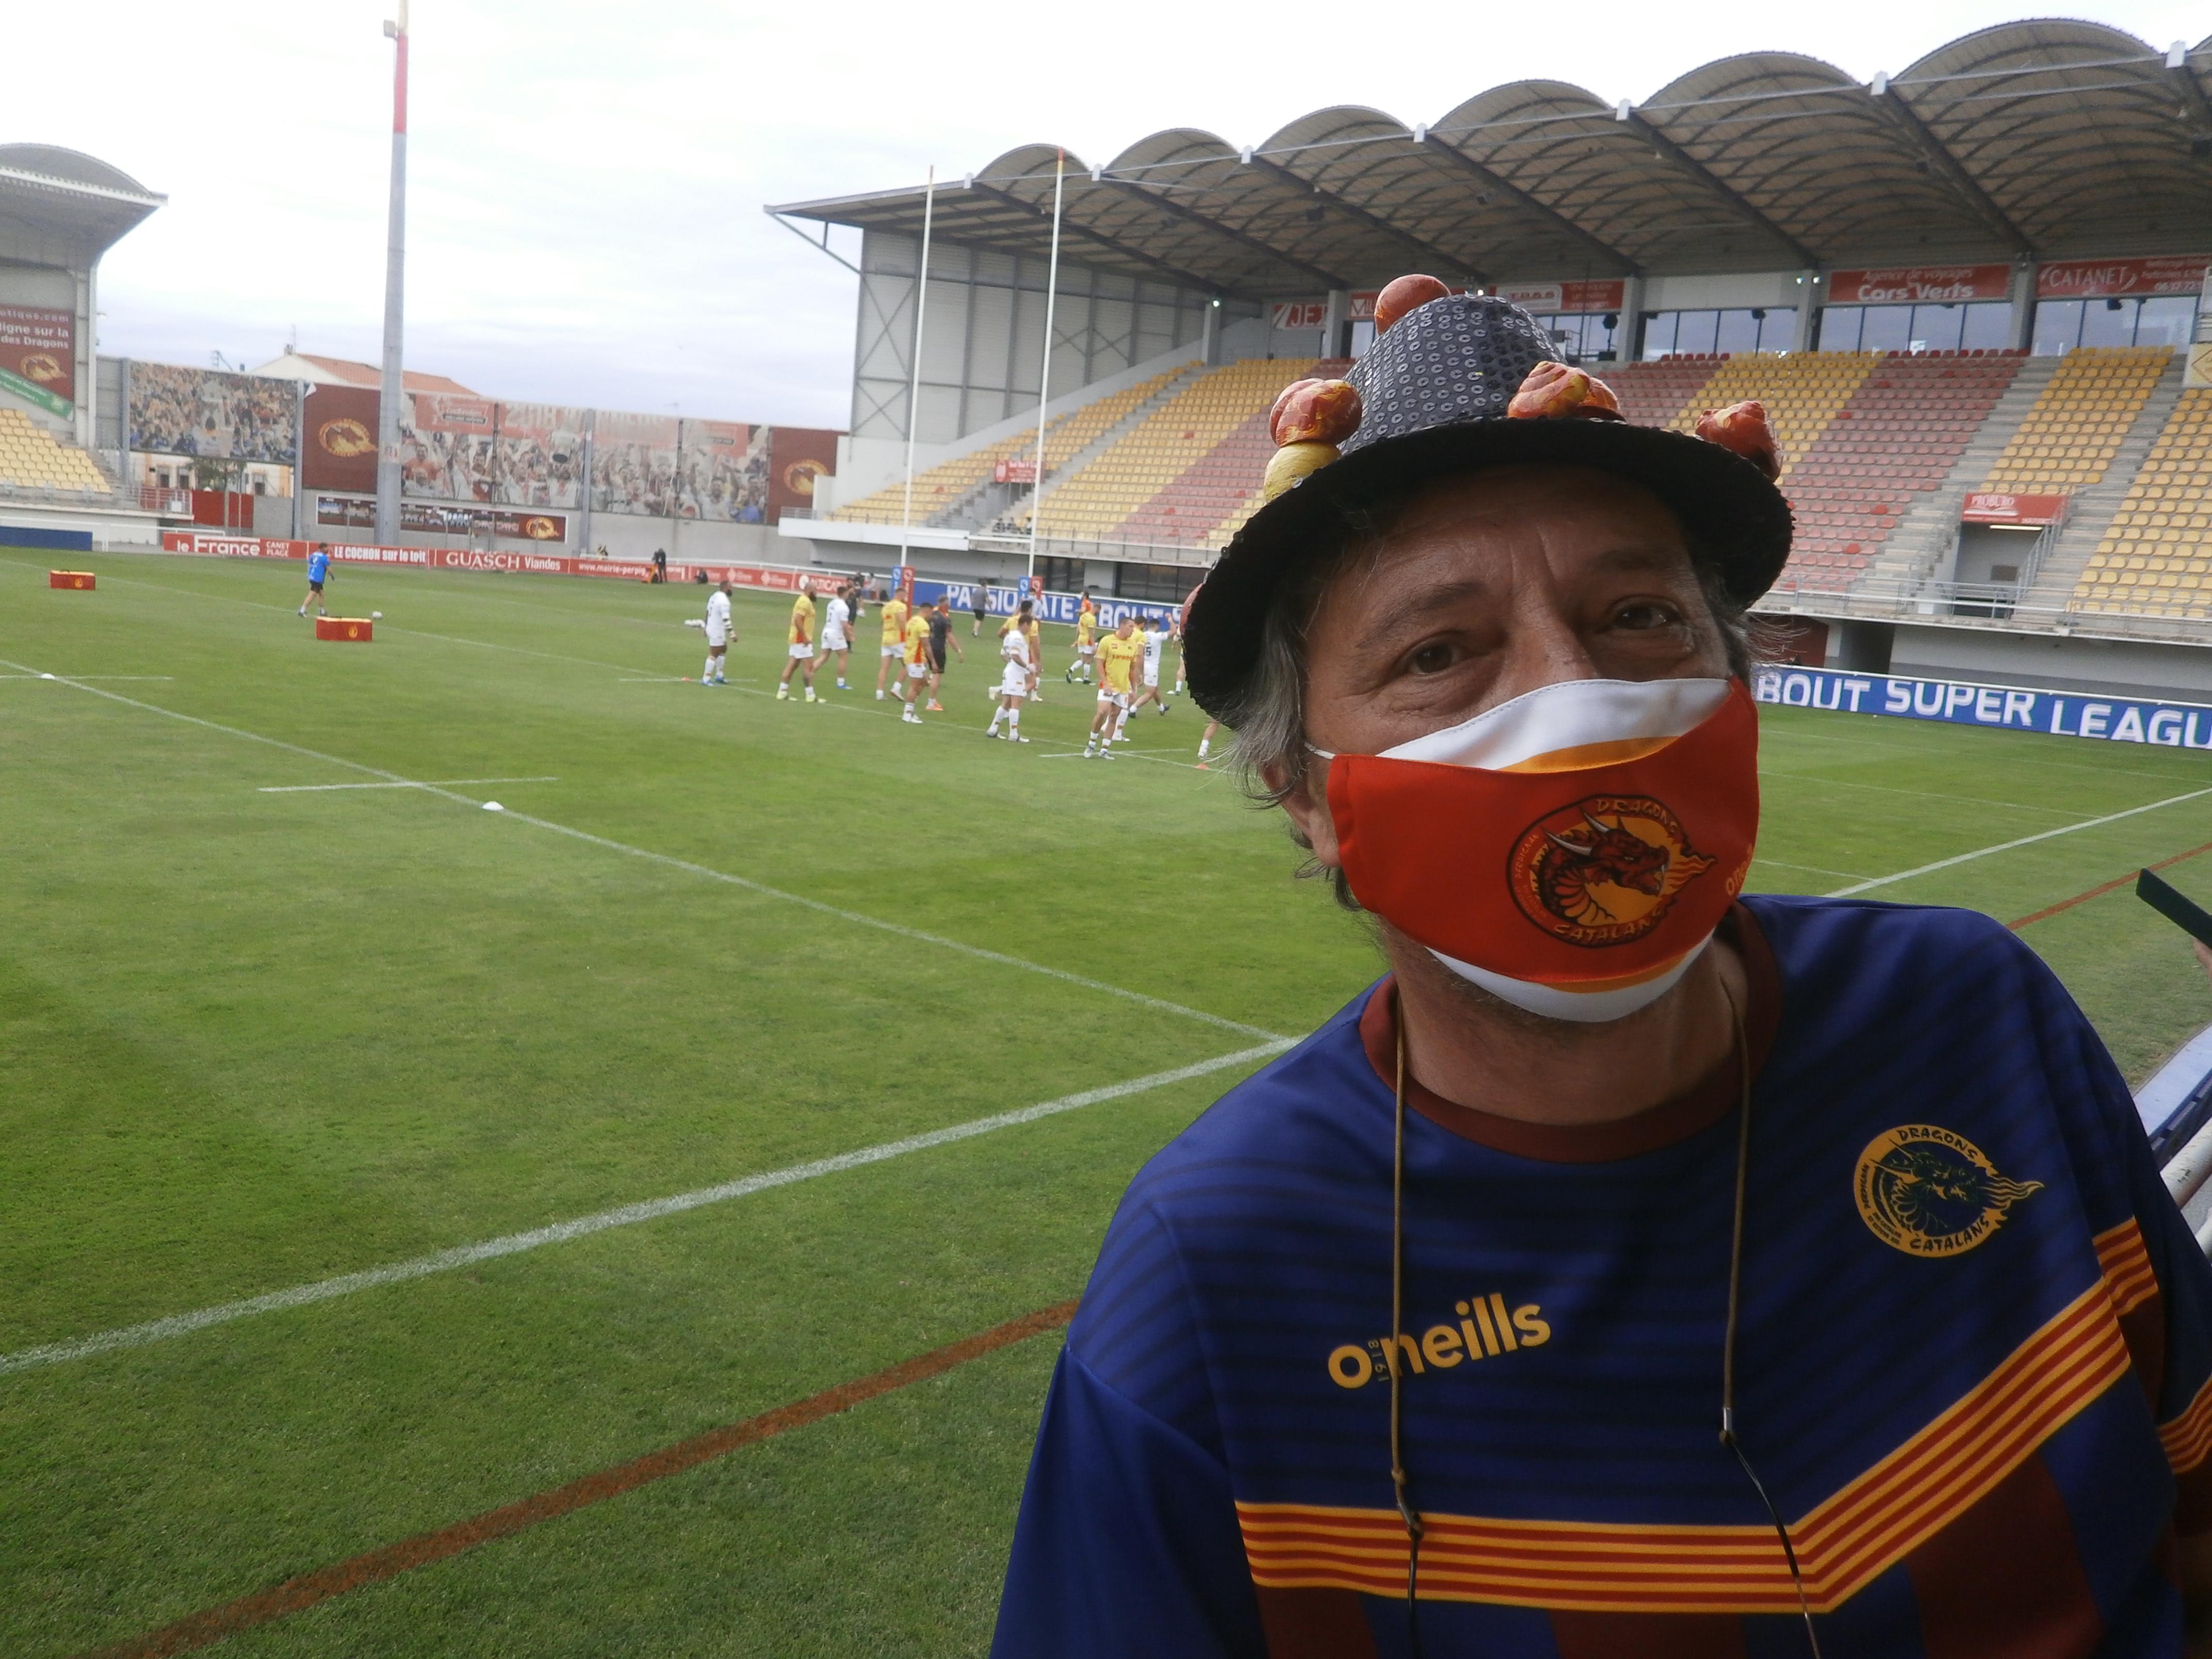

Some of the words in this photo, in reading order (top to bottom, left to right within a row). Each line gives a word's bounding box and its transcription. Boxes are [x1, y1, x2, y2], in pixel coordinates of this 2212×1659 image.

[2050, 266, 2130, 287] CATANET
[1858, 285, 1909, 301] Cars
[1909, 282, 1974, 299] Verts
[1, 335, 21, 345] des
[23, 336, 69, 350] Dragons
[34, 327, 54, 337] sur
[57, 326, 69, 338] la
[177, 540, 189, 552] le
[194, 535, 261, 557] France
[334, 545, 344, 559] LE
[345, 546, 381, 561] COCHON
[382, 549, 398, 561] sur
[399, 547, 409, 562] le
[410, 549, 426, 563] toit
[446, 551, 519, 570] GUASCH
[524, 555, 561, 571] Viandes
[1884, 679, 2036, 727] SUPER
[1596, 799, 1678, 834] DRAGONS
[1554, 908, 1662, 940] CATALANS
[1897, 1127, 1978, 1160] DRAGONS
[1910, 1215, 1990, 1251] CATALANS
[1327, 1292, 1552, 1389] oneills
